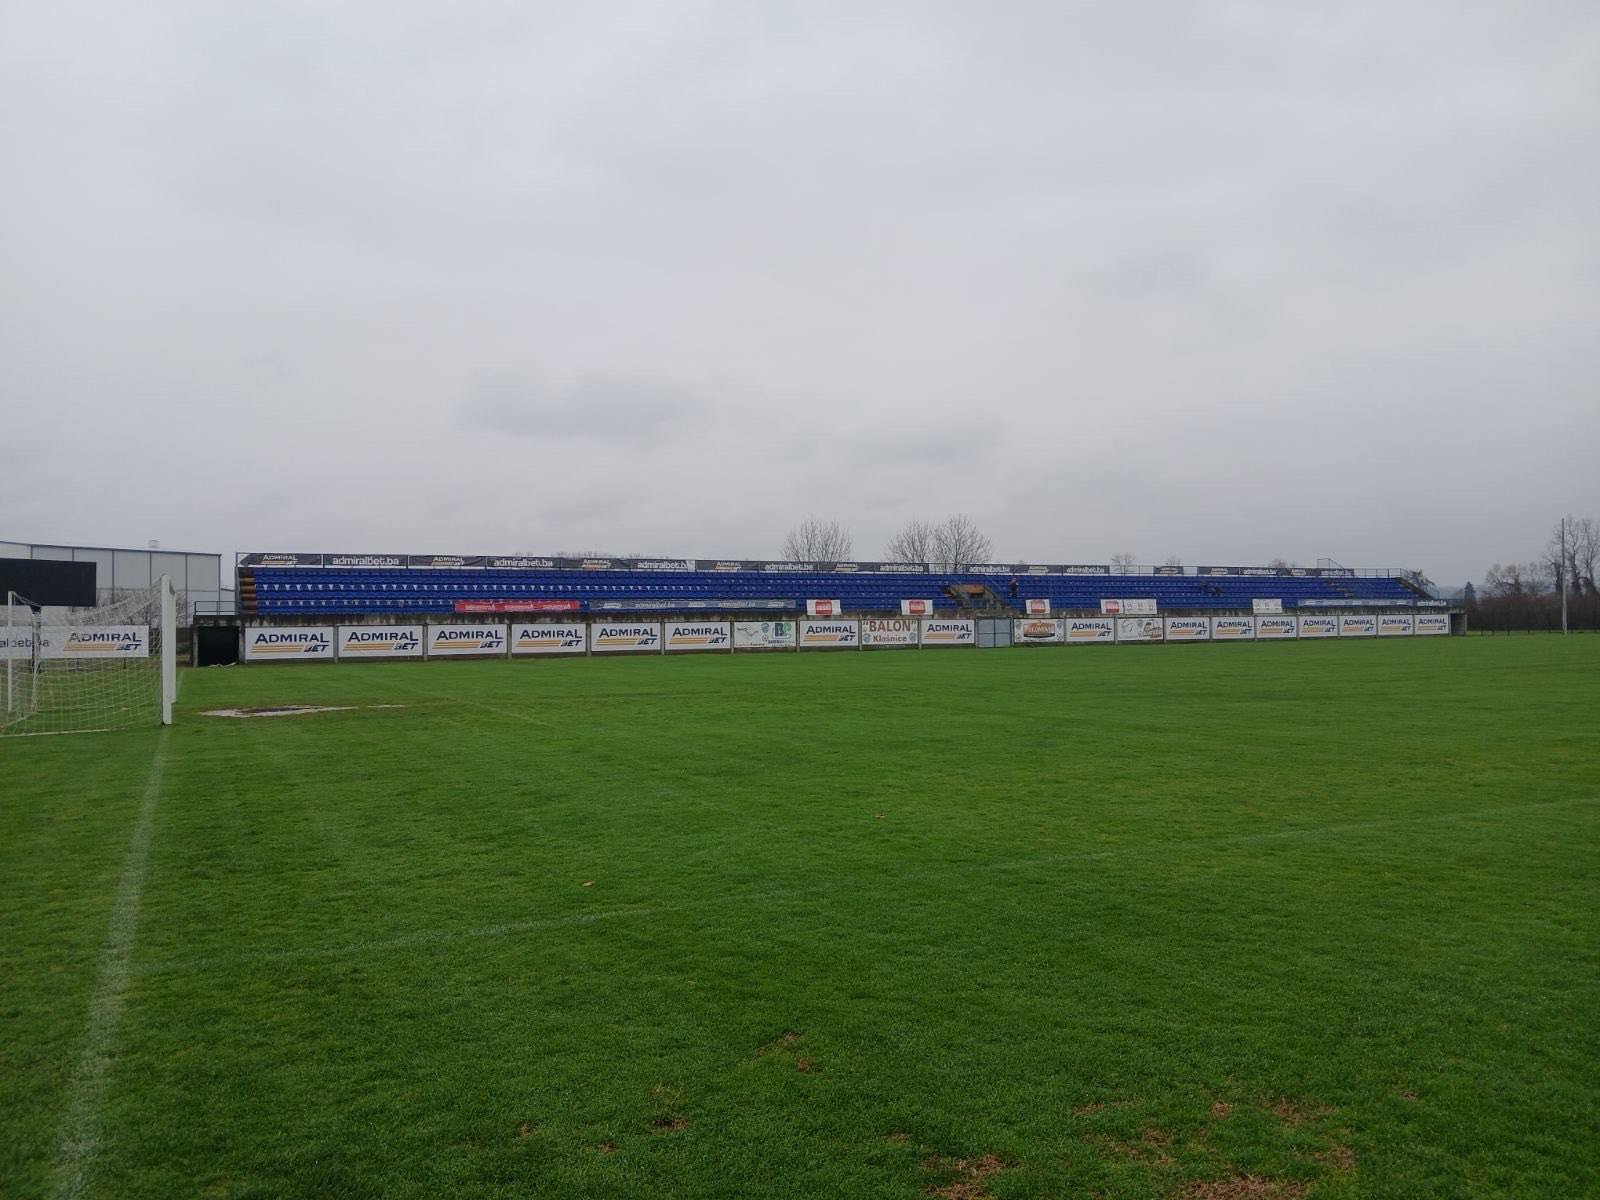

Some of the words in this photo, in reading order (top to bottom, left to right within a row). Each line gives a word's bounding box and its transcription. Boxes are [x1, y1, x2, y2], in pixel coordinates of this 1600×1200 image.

[333, 557, 399, 565] admiralbet.ba
[494, 559, 553, 567] admiralbet.ba
[807, 625, 855, 634] ADMIRAL
[927, 624, 972, 632] ADMIRAL
[1170, 621, 1207, 629] ADMIRAL
[437, 630, 503, 640] ADMIRAL
[520, 629, 582, 639] ADMIRAL
[599, 627, 657, 638] ADMIRAL
[672, 627, 727, 636] ADMIRAL
[70, 632, 142, 642] ADMIRAL
[255, 632, 329, 644] ADMIRAL
[348, 631, 418, 642] ADMIRAL
